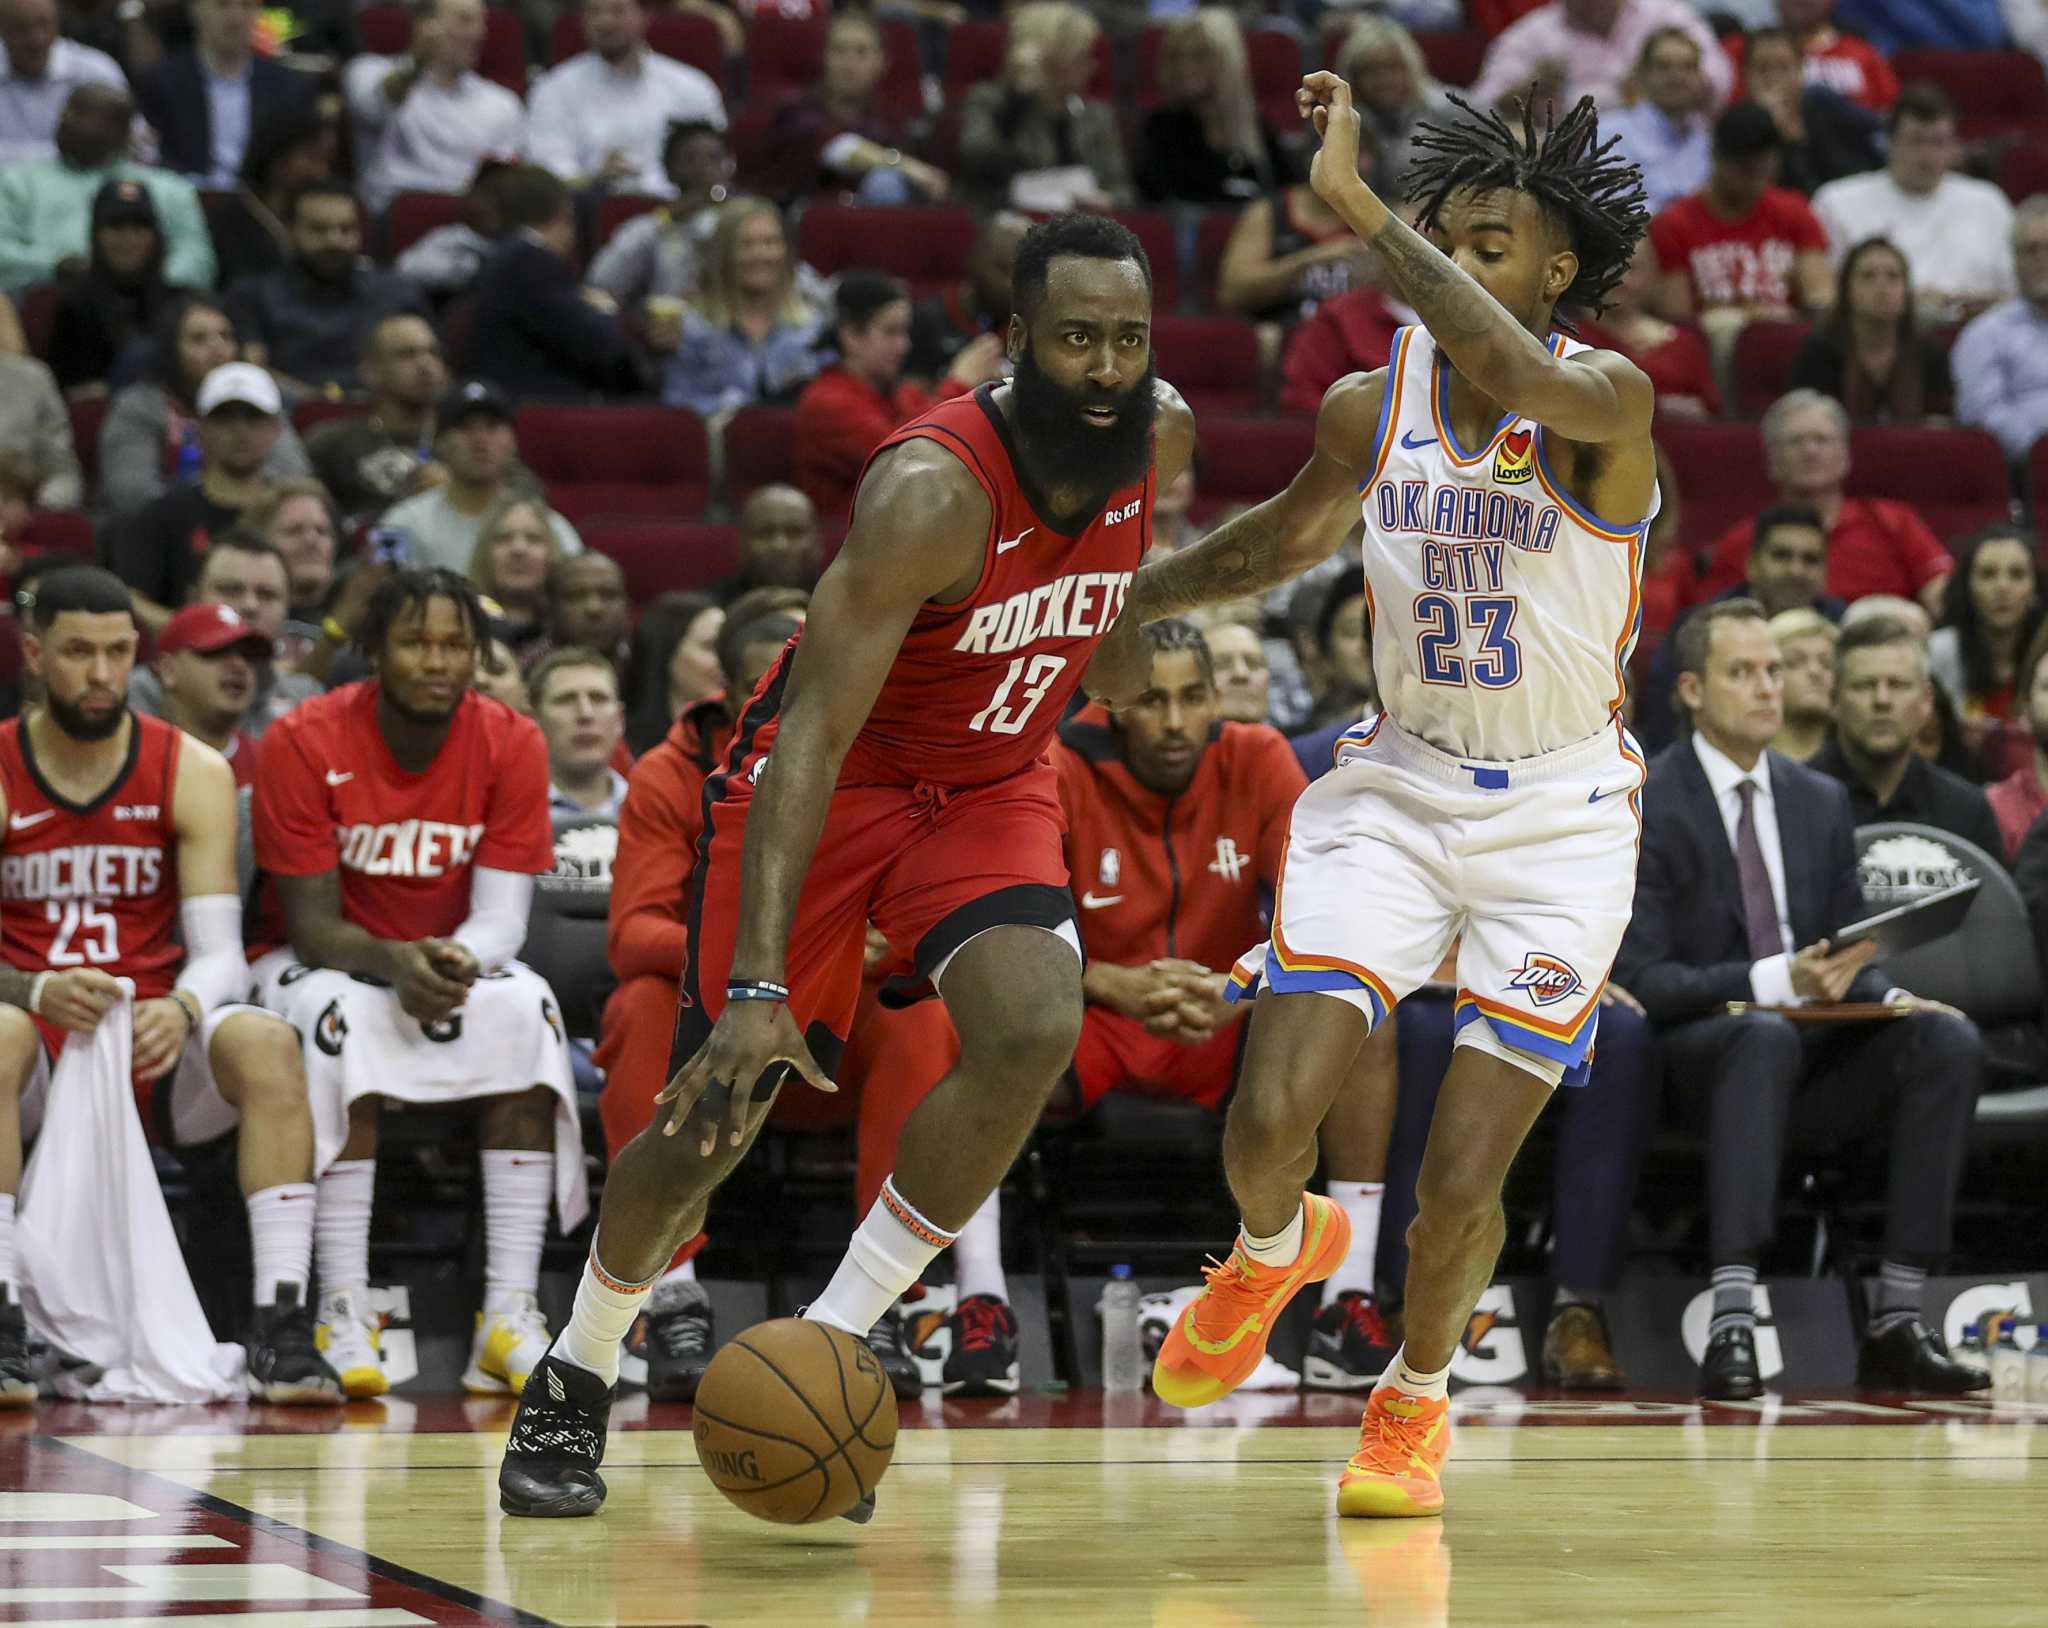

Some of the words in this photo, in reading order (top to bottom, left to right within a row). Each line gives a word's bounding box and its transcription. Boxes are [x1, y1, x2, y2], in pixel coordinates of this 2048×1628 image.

[1496, 461, 1532, 480] Love's
[1377, 481, 1562, 553] OKAHOMA
[1422, 540, 1504, 592] CITY
[953, 571, 1133, 654] ROCKETS
[1413, 592, 1523, 690] 23
[968, 654, 1067, 735] 13
[1, 844, 162, 899] ROCKETS
[46, 897, 121, 966] 25
[1511, 966, 1572, 986] OKC
